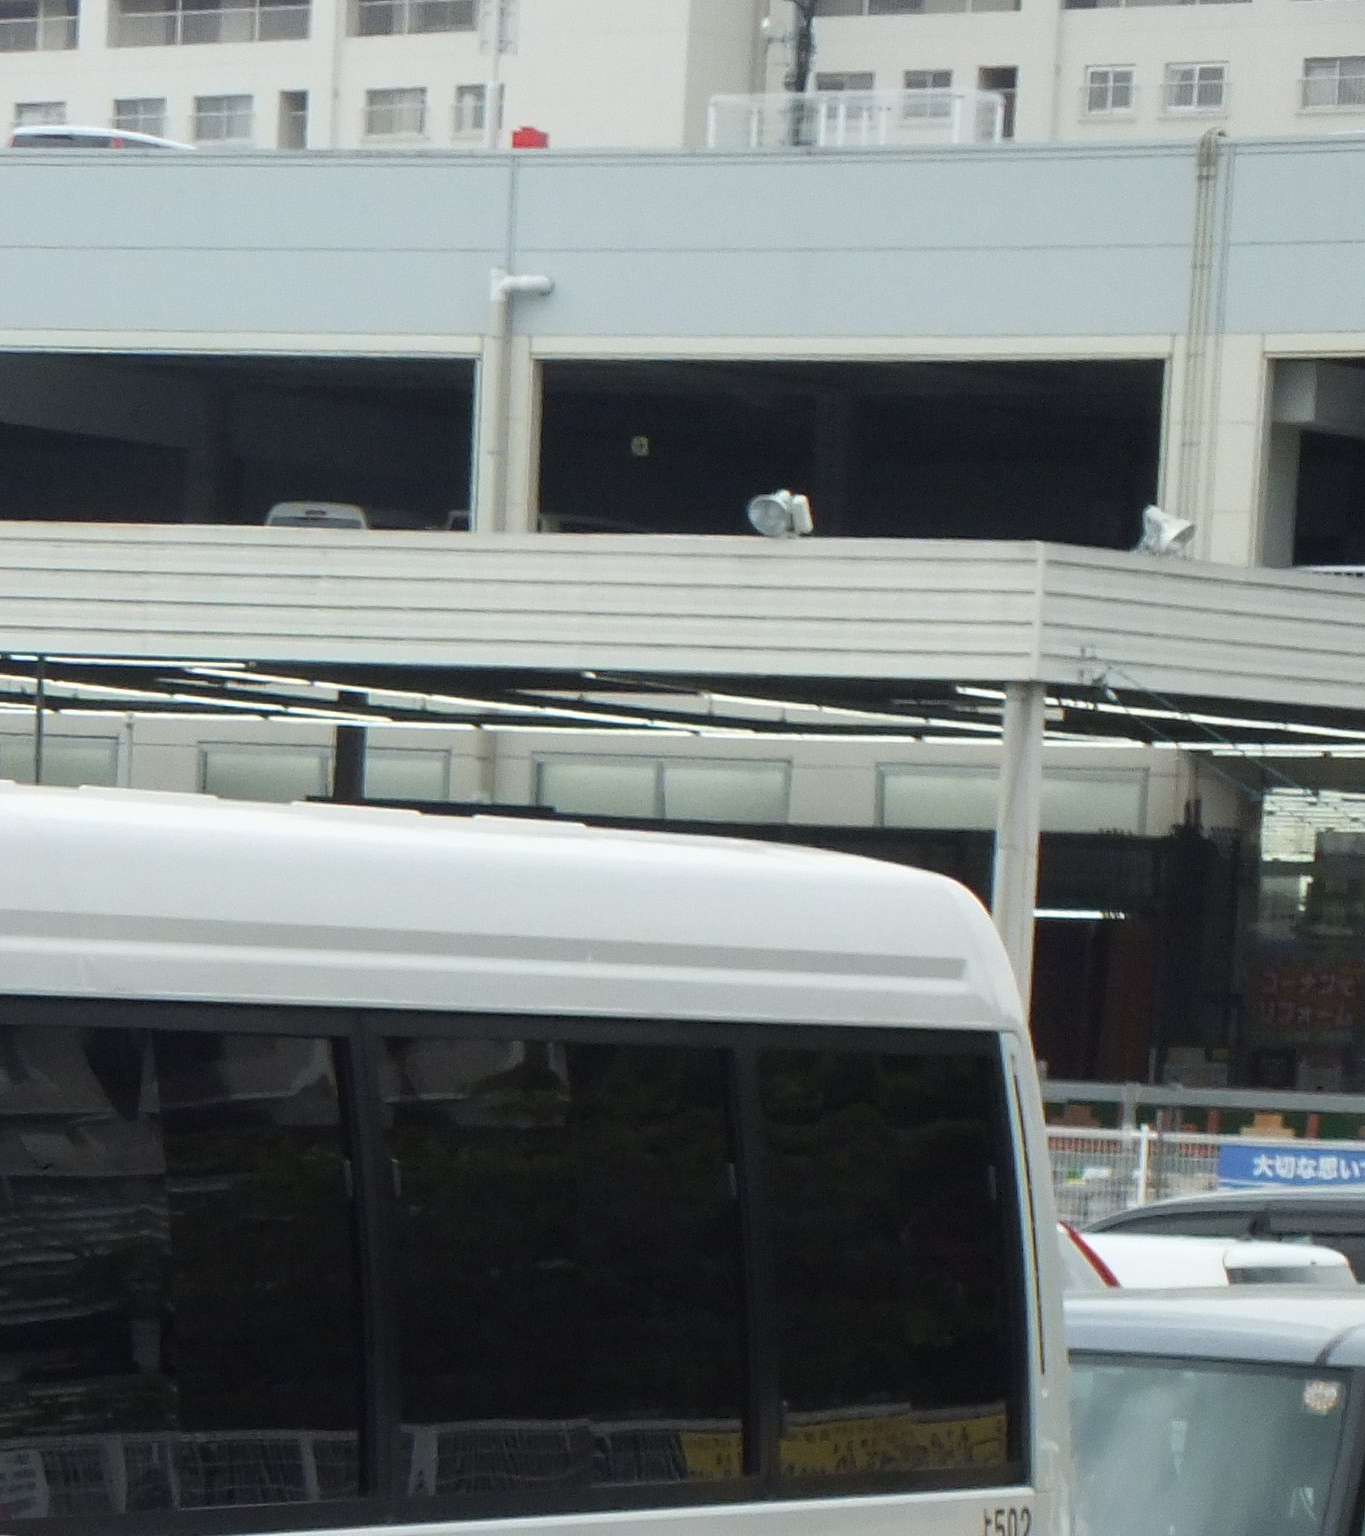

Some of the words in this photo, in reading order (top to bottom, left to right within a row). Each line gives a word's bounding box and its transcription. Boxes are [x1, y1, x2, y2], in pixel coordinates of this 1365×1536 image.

[1252, 1153, 1365, 1180] 大切な思い
